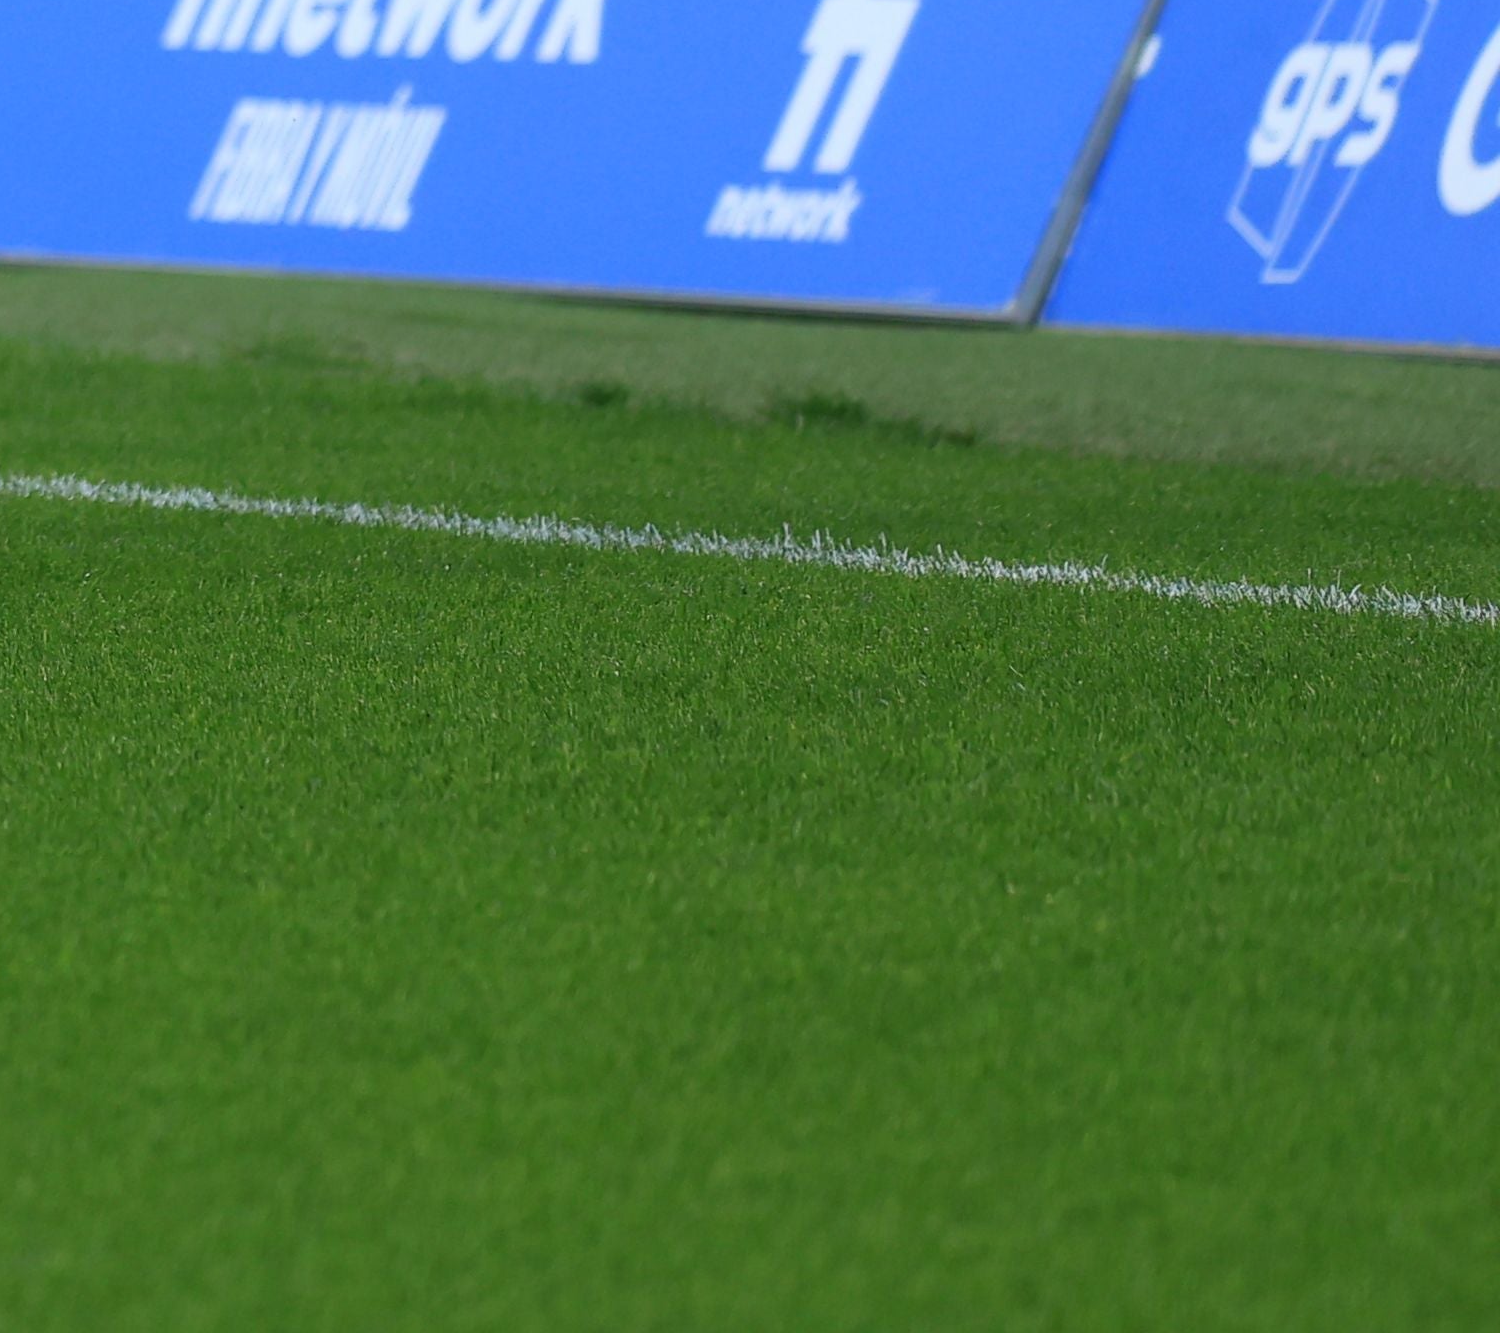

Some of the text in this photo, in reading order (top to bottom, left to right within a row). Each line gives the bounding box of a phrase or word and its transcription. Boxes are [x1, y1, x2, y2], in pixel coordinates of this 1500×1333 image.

[188, 97, 322, 223] FIBRA
[1247, 40, 1421, 169] gps
[703, 177, 863, 243] network
